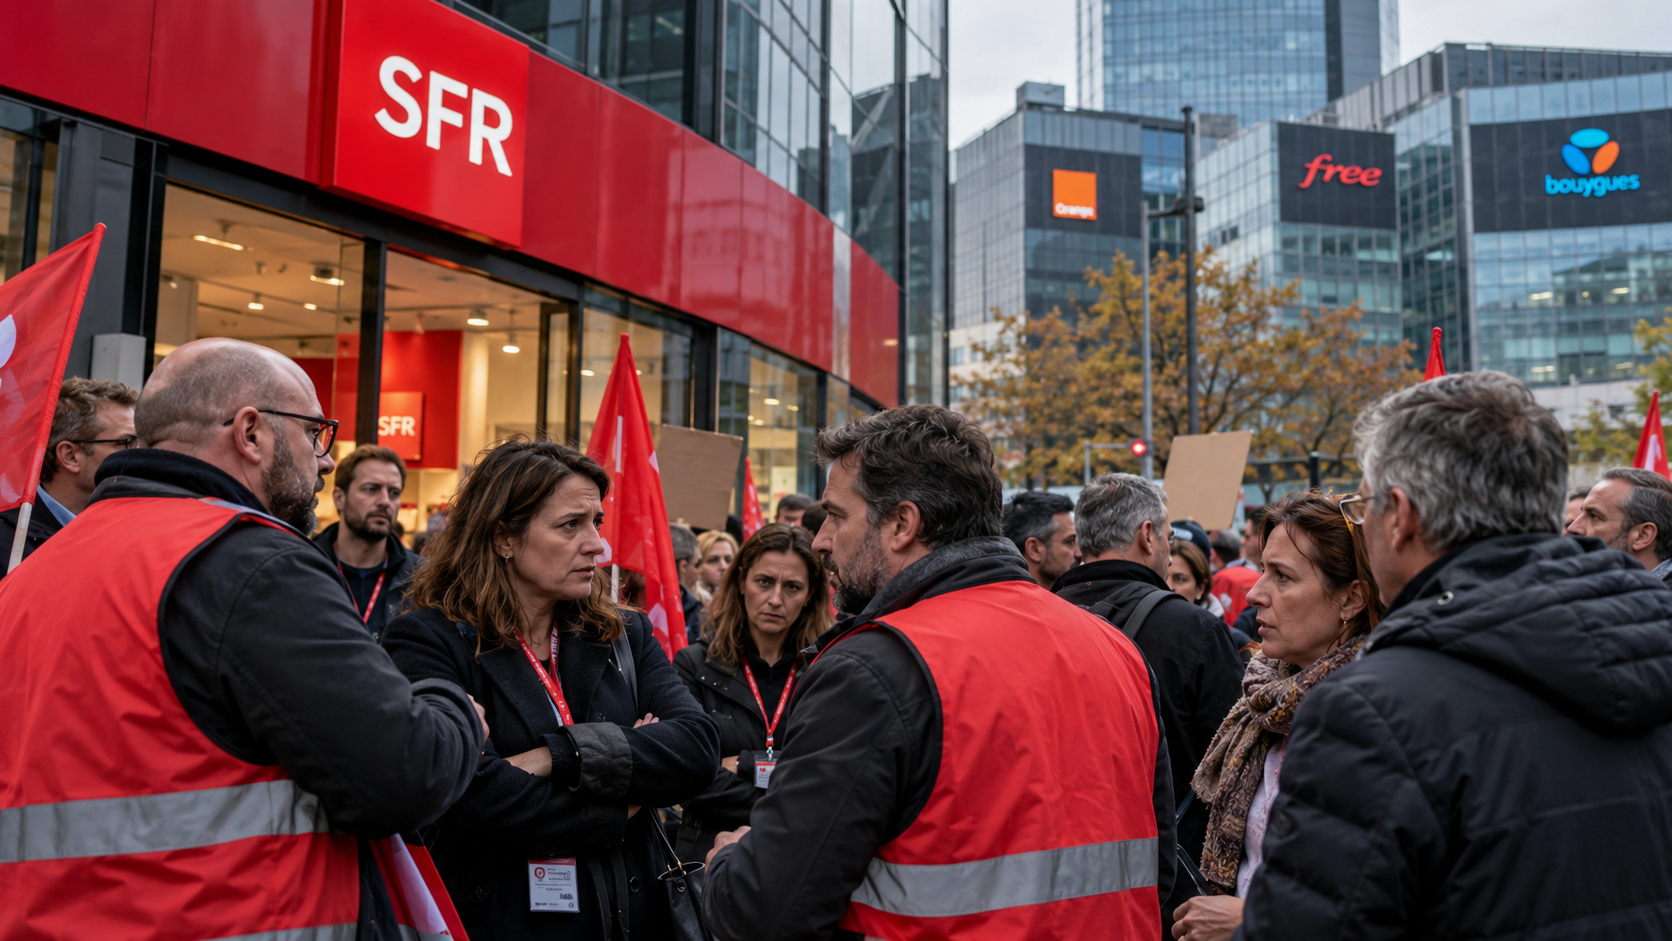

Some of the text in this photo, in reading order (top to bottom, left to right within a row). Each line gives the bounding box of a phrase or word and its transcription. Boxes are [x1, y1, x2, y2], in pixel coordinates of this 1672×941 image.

[374, 55, 514, 177] SFR
[1298, 153, 1383, 189] free
[1545, 173, 1641, 198] bouygues
[378, 415, 415, 437] SFR
